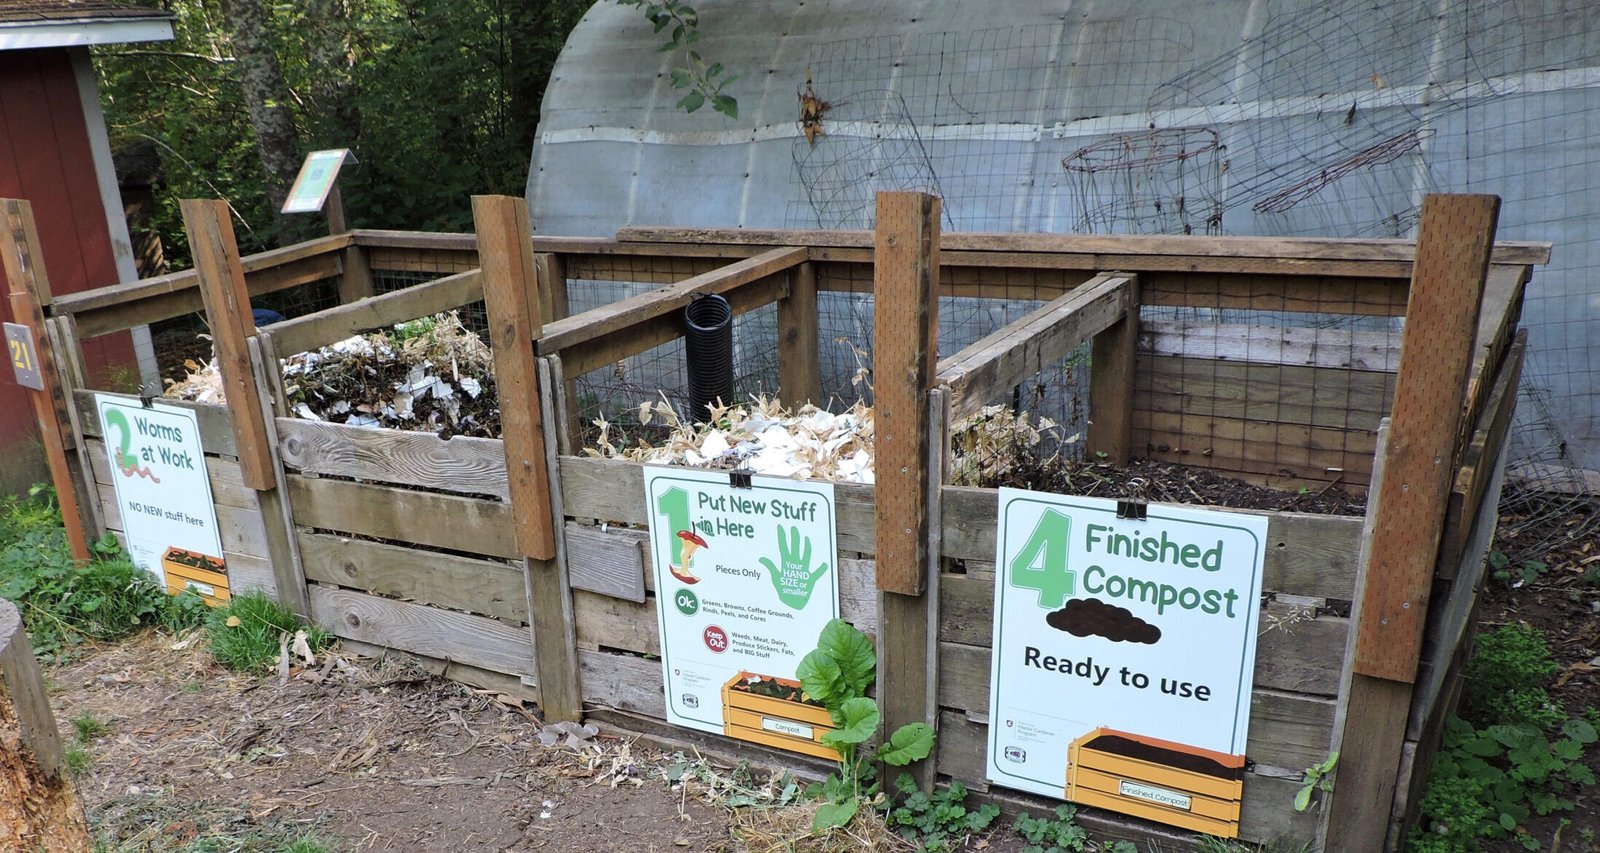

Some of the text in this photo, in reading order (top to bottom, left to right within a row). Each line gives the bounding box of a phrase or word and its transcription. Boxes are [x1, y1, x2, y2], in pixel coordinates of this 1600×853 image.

[10, 340, 32, 371] 21
[104, 408, 138, 468] 2
[134, 416, 182, 443] Worms
[141, 446, 194, 470] at Work
[129, 502, 204, 527] NO NEW stuff here
[698, 492, 817, 522] Put New Stuff
[658, 486, 694, 568] 1
[700, 516, 754, 538] in Here
[1010, 507, 1076, 609] 4
[1086, 524, 1223, 572] Finished
[716, 565, 761, 580] Pieces Only
[783, 569, 809, 580] HAND
[786, 562, 803, 570] Your
[780, 577, 798, 587] SIZE
[783, 588, 808, 596] smaller
[1083, 565, 1238, 618] Compost
[703, 607, 720, 615] Rinds,
[721, 610, 737, 618] Peels,
[750, 614, 766, 622] Cores
[748, 606, 766, 614] Coffee
[707, 630, 723, 641] Keep
[732, 632, 752, 641] Weeds,
[732, 640, 755, 648] Produce
[756, 644, 780, 653] Stickers,
[756, 651, 770, 659] Stuff
[1024, 646, 1211, 701] Ready to use
[775, 723, 800, 734] Compost
[1122, 786, 1188, 807] Finished Compost
